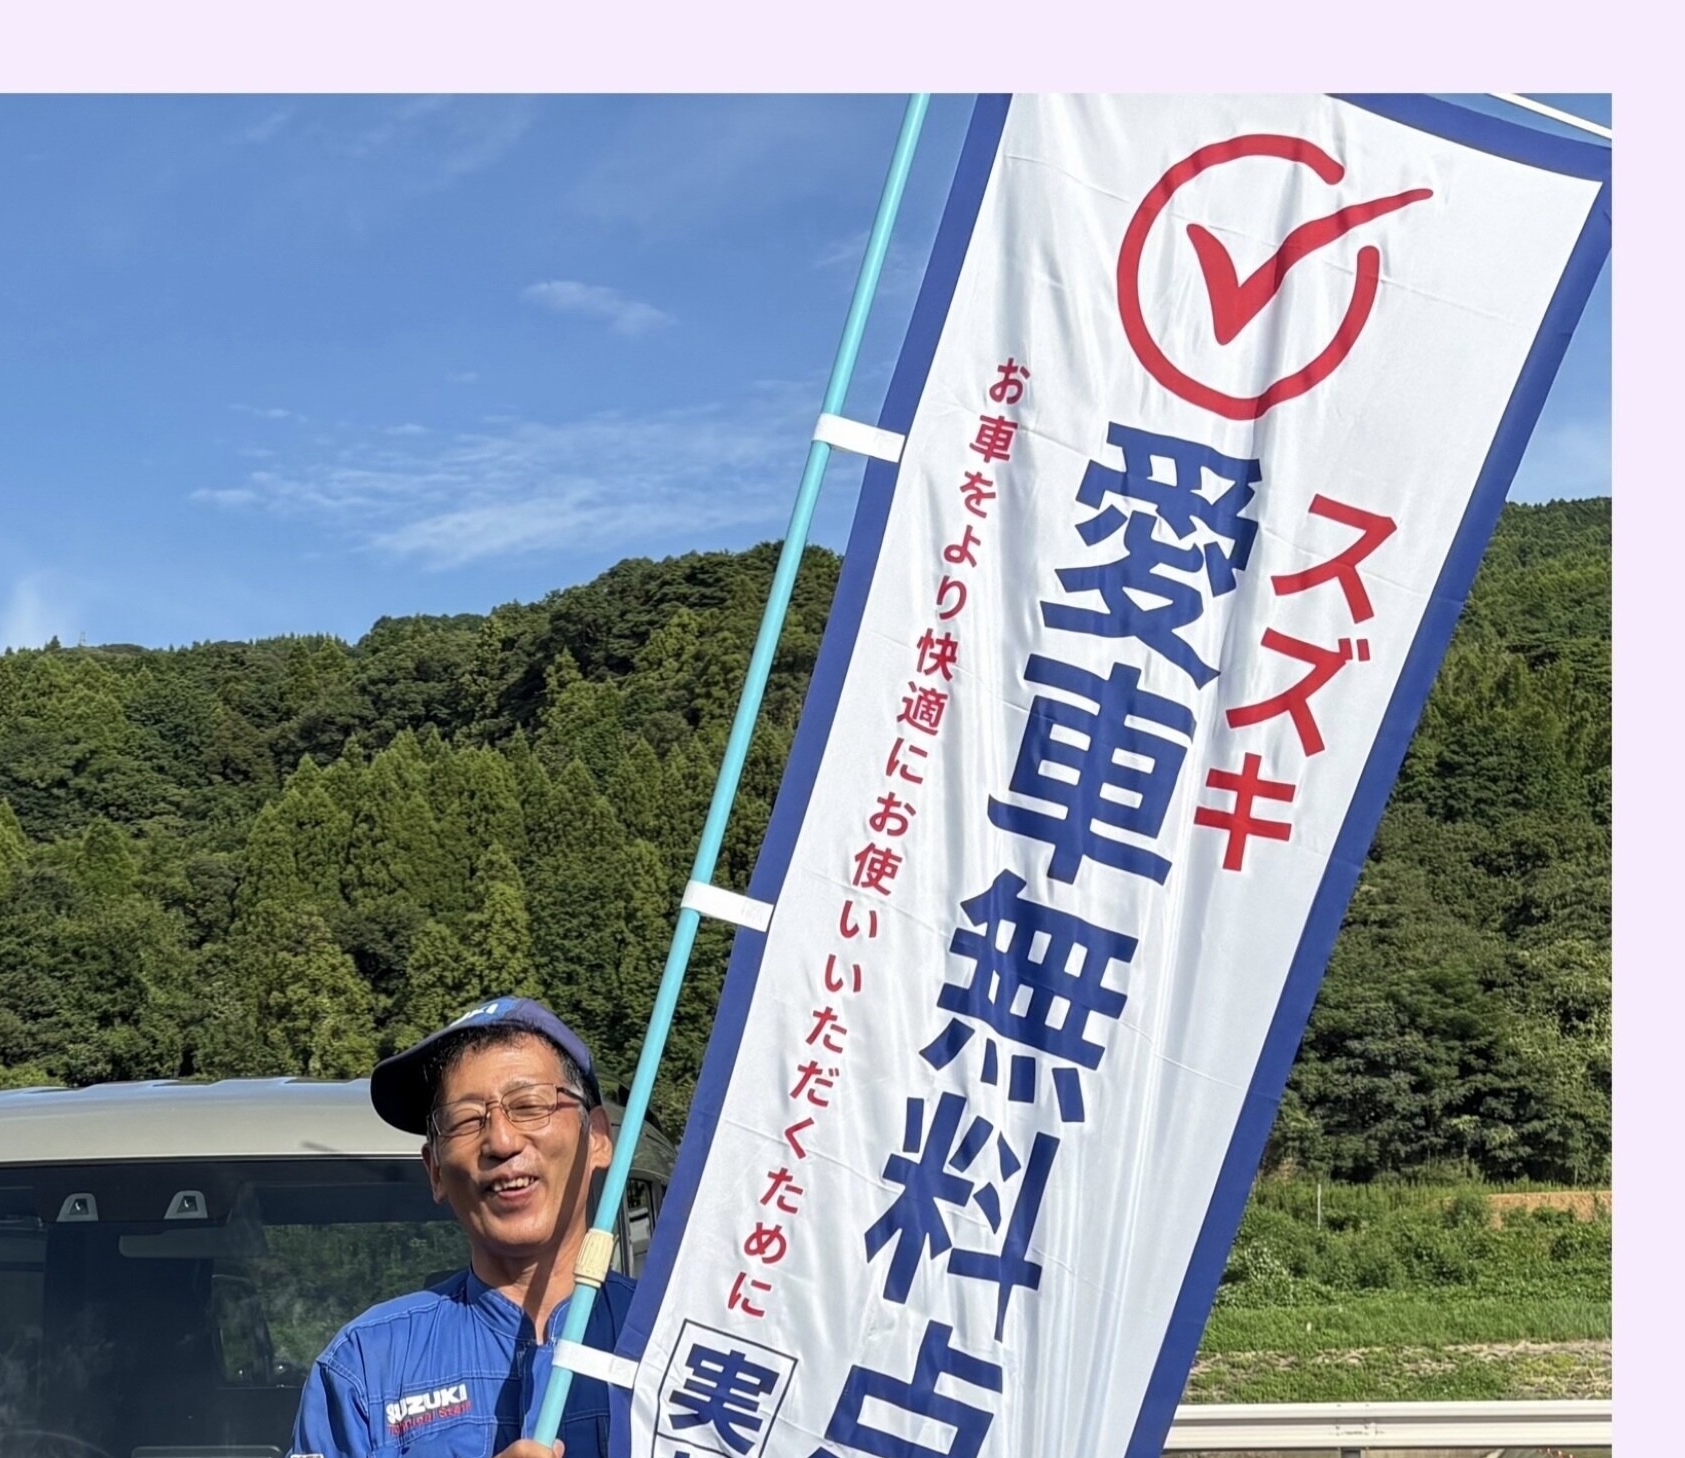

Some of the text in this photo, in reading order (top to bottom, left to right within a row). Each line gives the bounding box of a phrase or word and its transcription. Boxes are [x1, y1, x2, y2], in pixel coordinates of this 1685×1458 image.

[727, 357, 1029, 1318] お車をより快適にお使いいただくために
[1194, 493, 1397, 872] スズキ
[386, 1383, 468, 1424] SUZUKI
